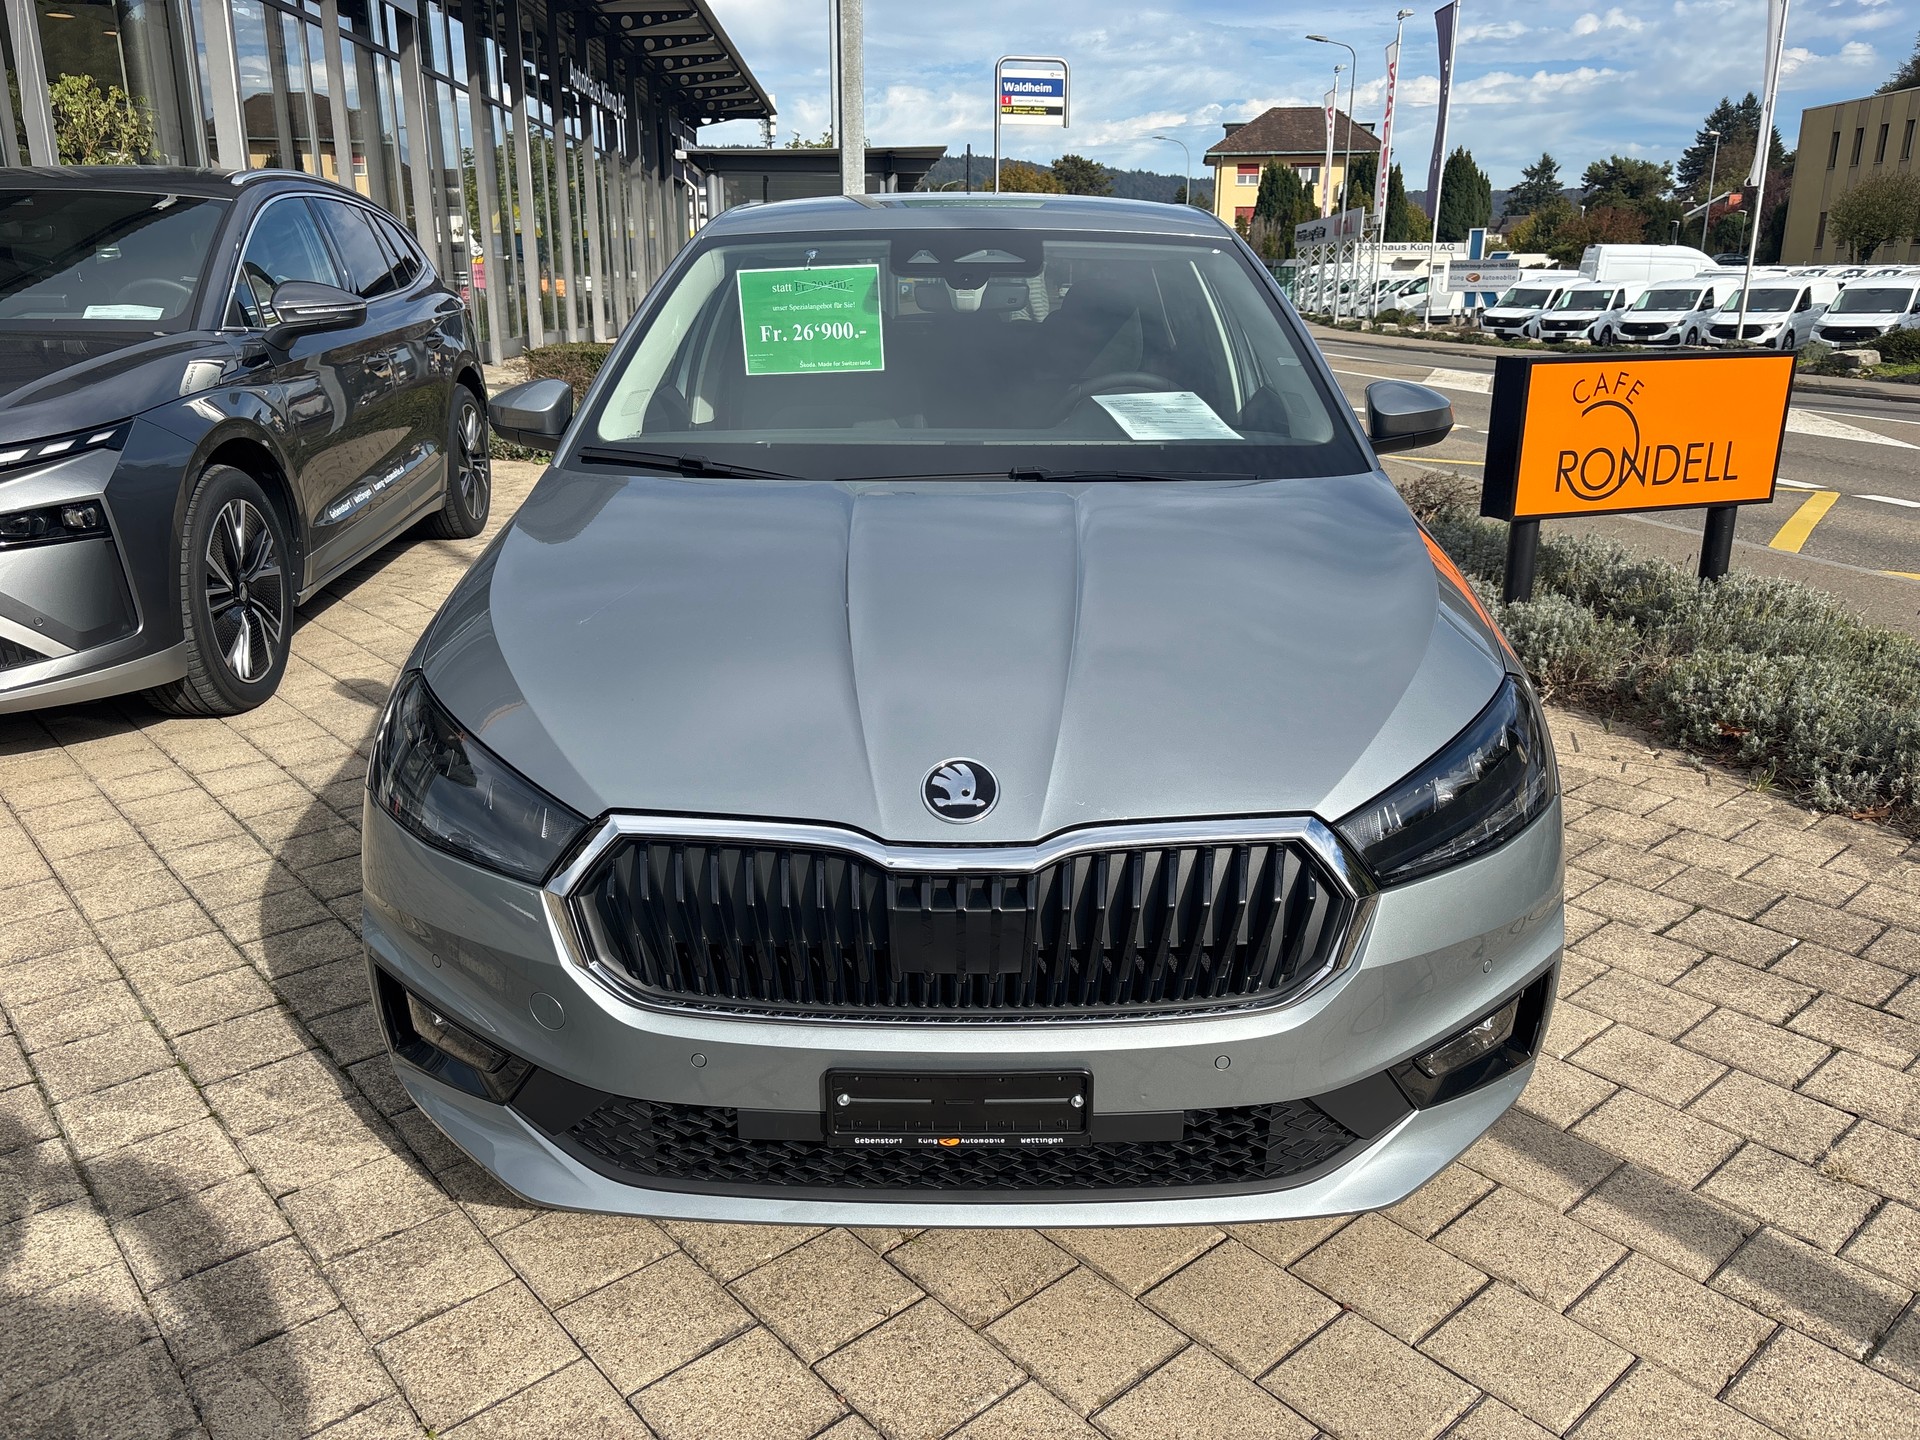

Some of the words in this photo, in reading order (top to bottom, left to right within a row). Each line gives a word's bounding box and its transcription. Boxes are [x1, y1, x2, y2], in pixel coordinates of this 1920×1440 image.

[570, 57, 601, 104] Autohaus
[618, 92, 627, 119] AG
[1003, 82, 1052, 93] Waldheim
[1439, 243, 1455, 251] AG
[771, 283, 792, 293] statt
[789, 302, 832, 312] Spezialangebot
[833, 301, 843, 309] für
[843, 301, 856, 309] Sie!
[760, 325, 787, 343] Fr.
[841, 359, 873, 367] Switzerland.
[1572, 371, 1645, 405] CAFE
[1555, 440, 1738, 502] RONDELL
[854, 1137, 903, 1145] Gebenstorf
[918, 1137, 938, 1145] Küng
[1020, 1137, 1064, 1145] Wettingen
